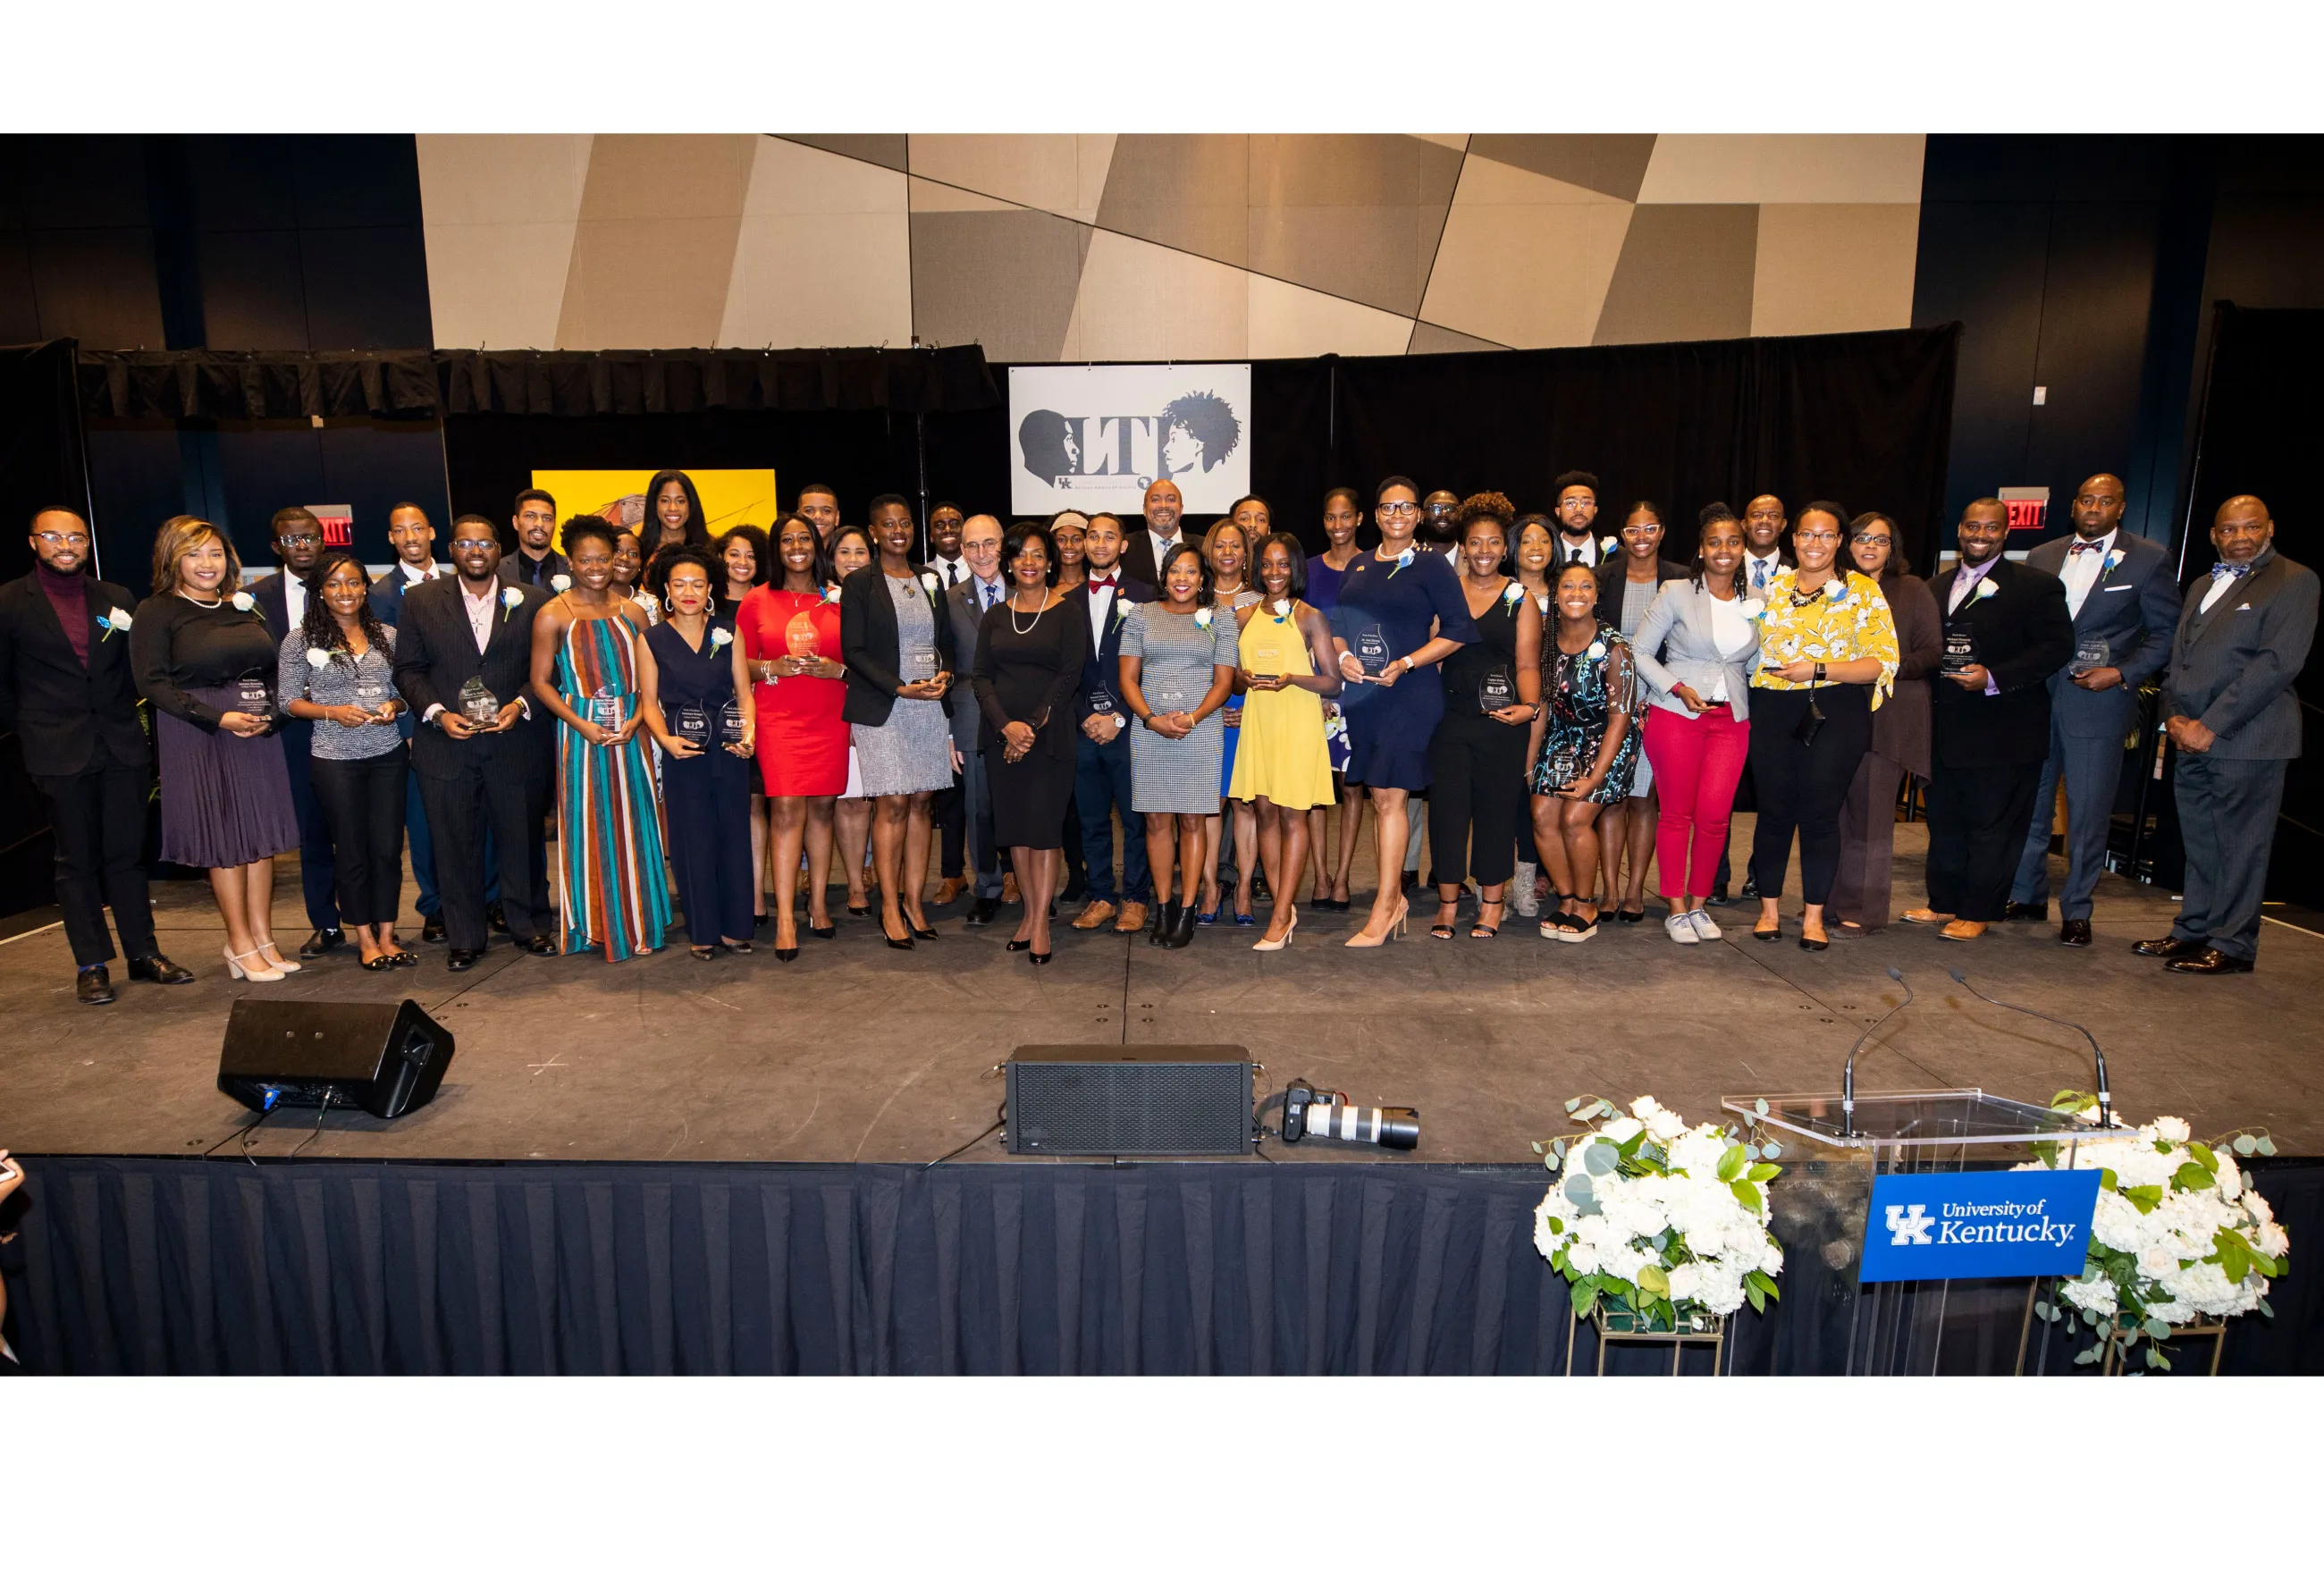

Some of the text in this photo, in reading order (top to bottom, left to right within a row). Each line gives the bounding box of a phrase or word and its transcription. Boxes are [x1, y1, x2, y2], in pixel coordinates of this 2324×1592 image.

[2008, 501, 2043, 526] EXIT
[319, 518, 345, 543] XIT
[1942, 1199, 2046, 1218] University of
[1885, 1204, 1935, 1246] UK
[1937, 1215, 2076, 1248] Kentucky
